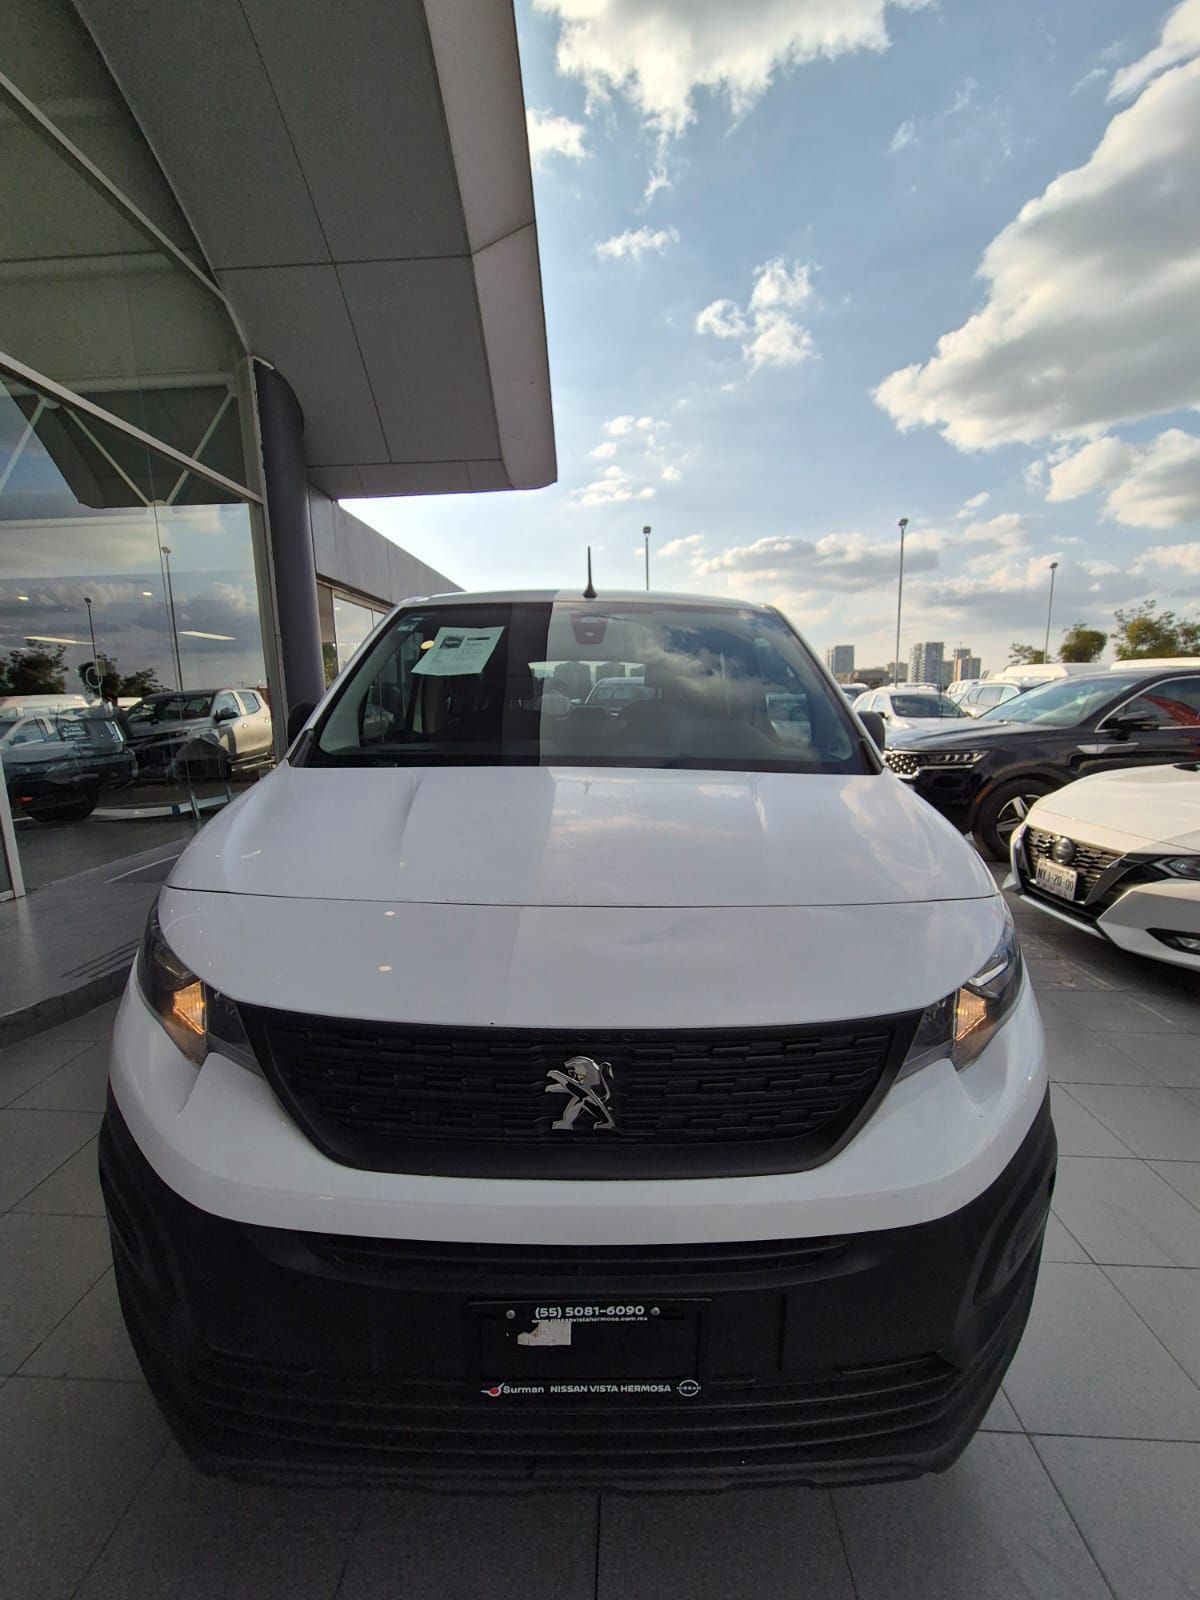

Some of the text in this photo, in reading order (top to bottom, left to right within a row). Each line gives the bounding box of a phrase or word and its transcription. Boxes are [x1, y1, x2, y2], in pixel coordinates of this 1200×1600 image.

[535, 1305, 645, 1319] (55) 5081-6090
[503, 1384, 545, 1395] Surman
[550, 1384, 588, 1394] NISSAN
[589, 1384, 619, 1394] VISTA
[620, 1383, 672, 1393] HERMOSA
